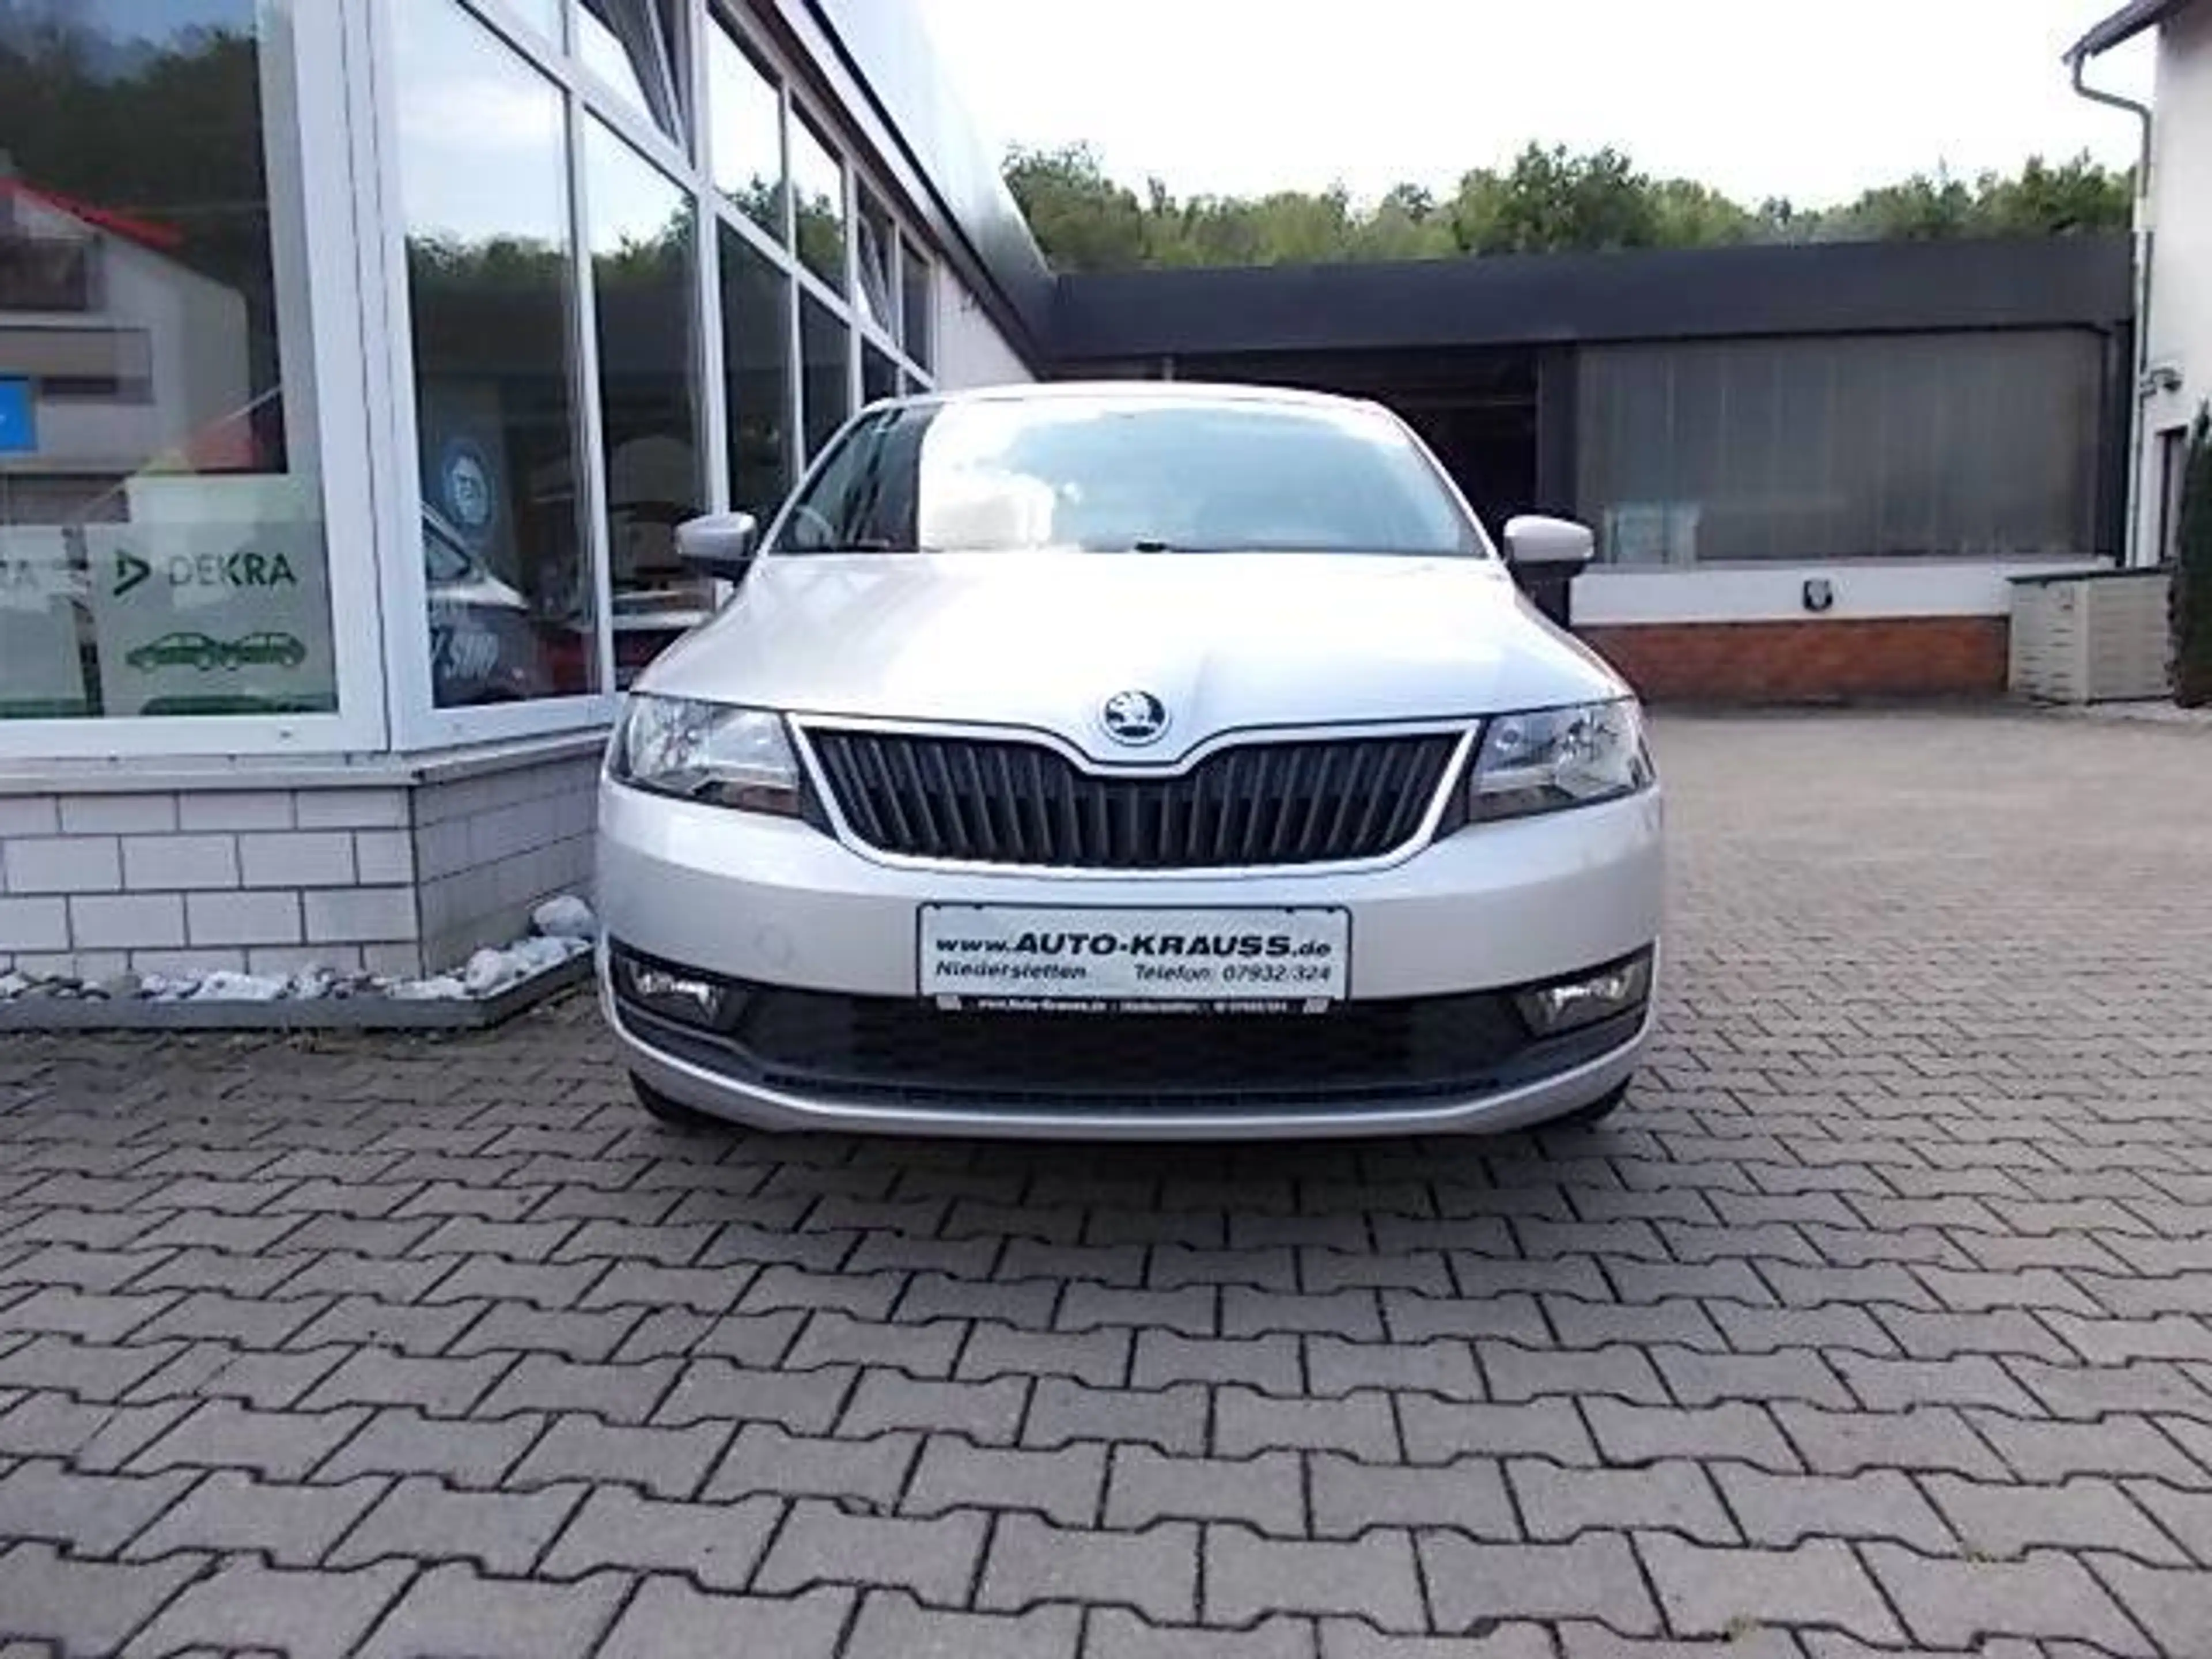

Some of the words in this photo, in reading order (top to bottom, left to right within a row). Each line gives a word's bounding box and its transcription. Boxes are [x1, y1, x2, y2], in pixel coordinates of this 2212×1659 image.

[168, 552, 298, 586] DEKRA
[935, 933, 1332, 958] www.AUTO-KRAUSS.de
[935, 961, 1086, 979] Niederstetten
